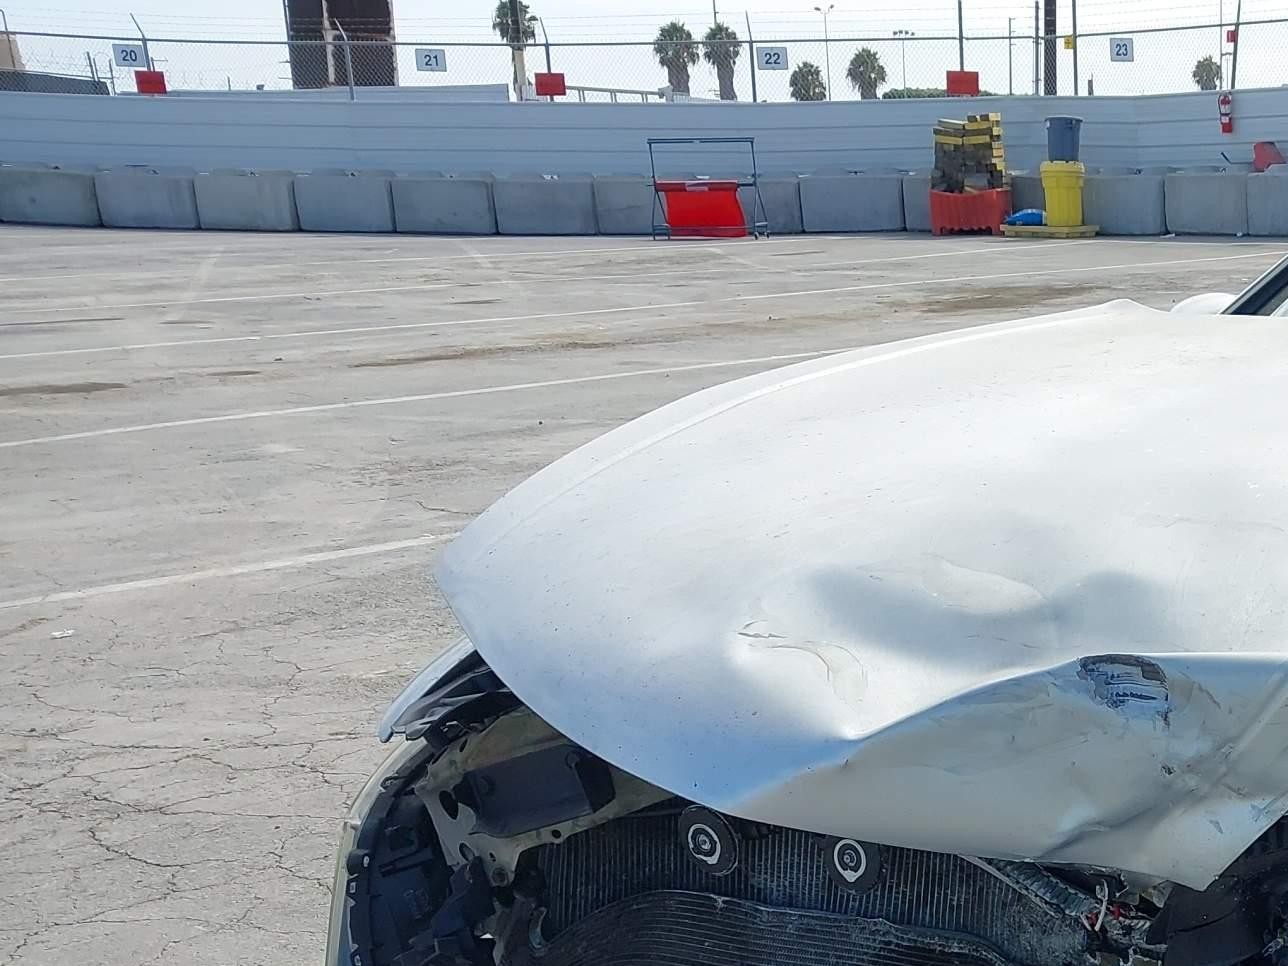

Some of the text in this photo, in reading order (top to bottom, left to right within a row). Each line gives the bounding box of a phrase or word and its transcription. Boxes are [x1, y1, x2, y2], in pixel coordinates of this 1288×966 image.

[120, 49, 138, 62] 20
[1115, 43, 1129, 57] 23
[423, 54, 439, 67] 21
[764, 52, 781, 65] 22
